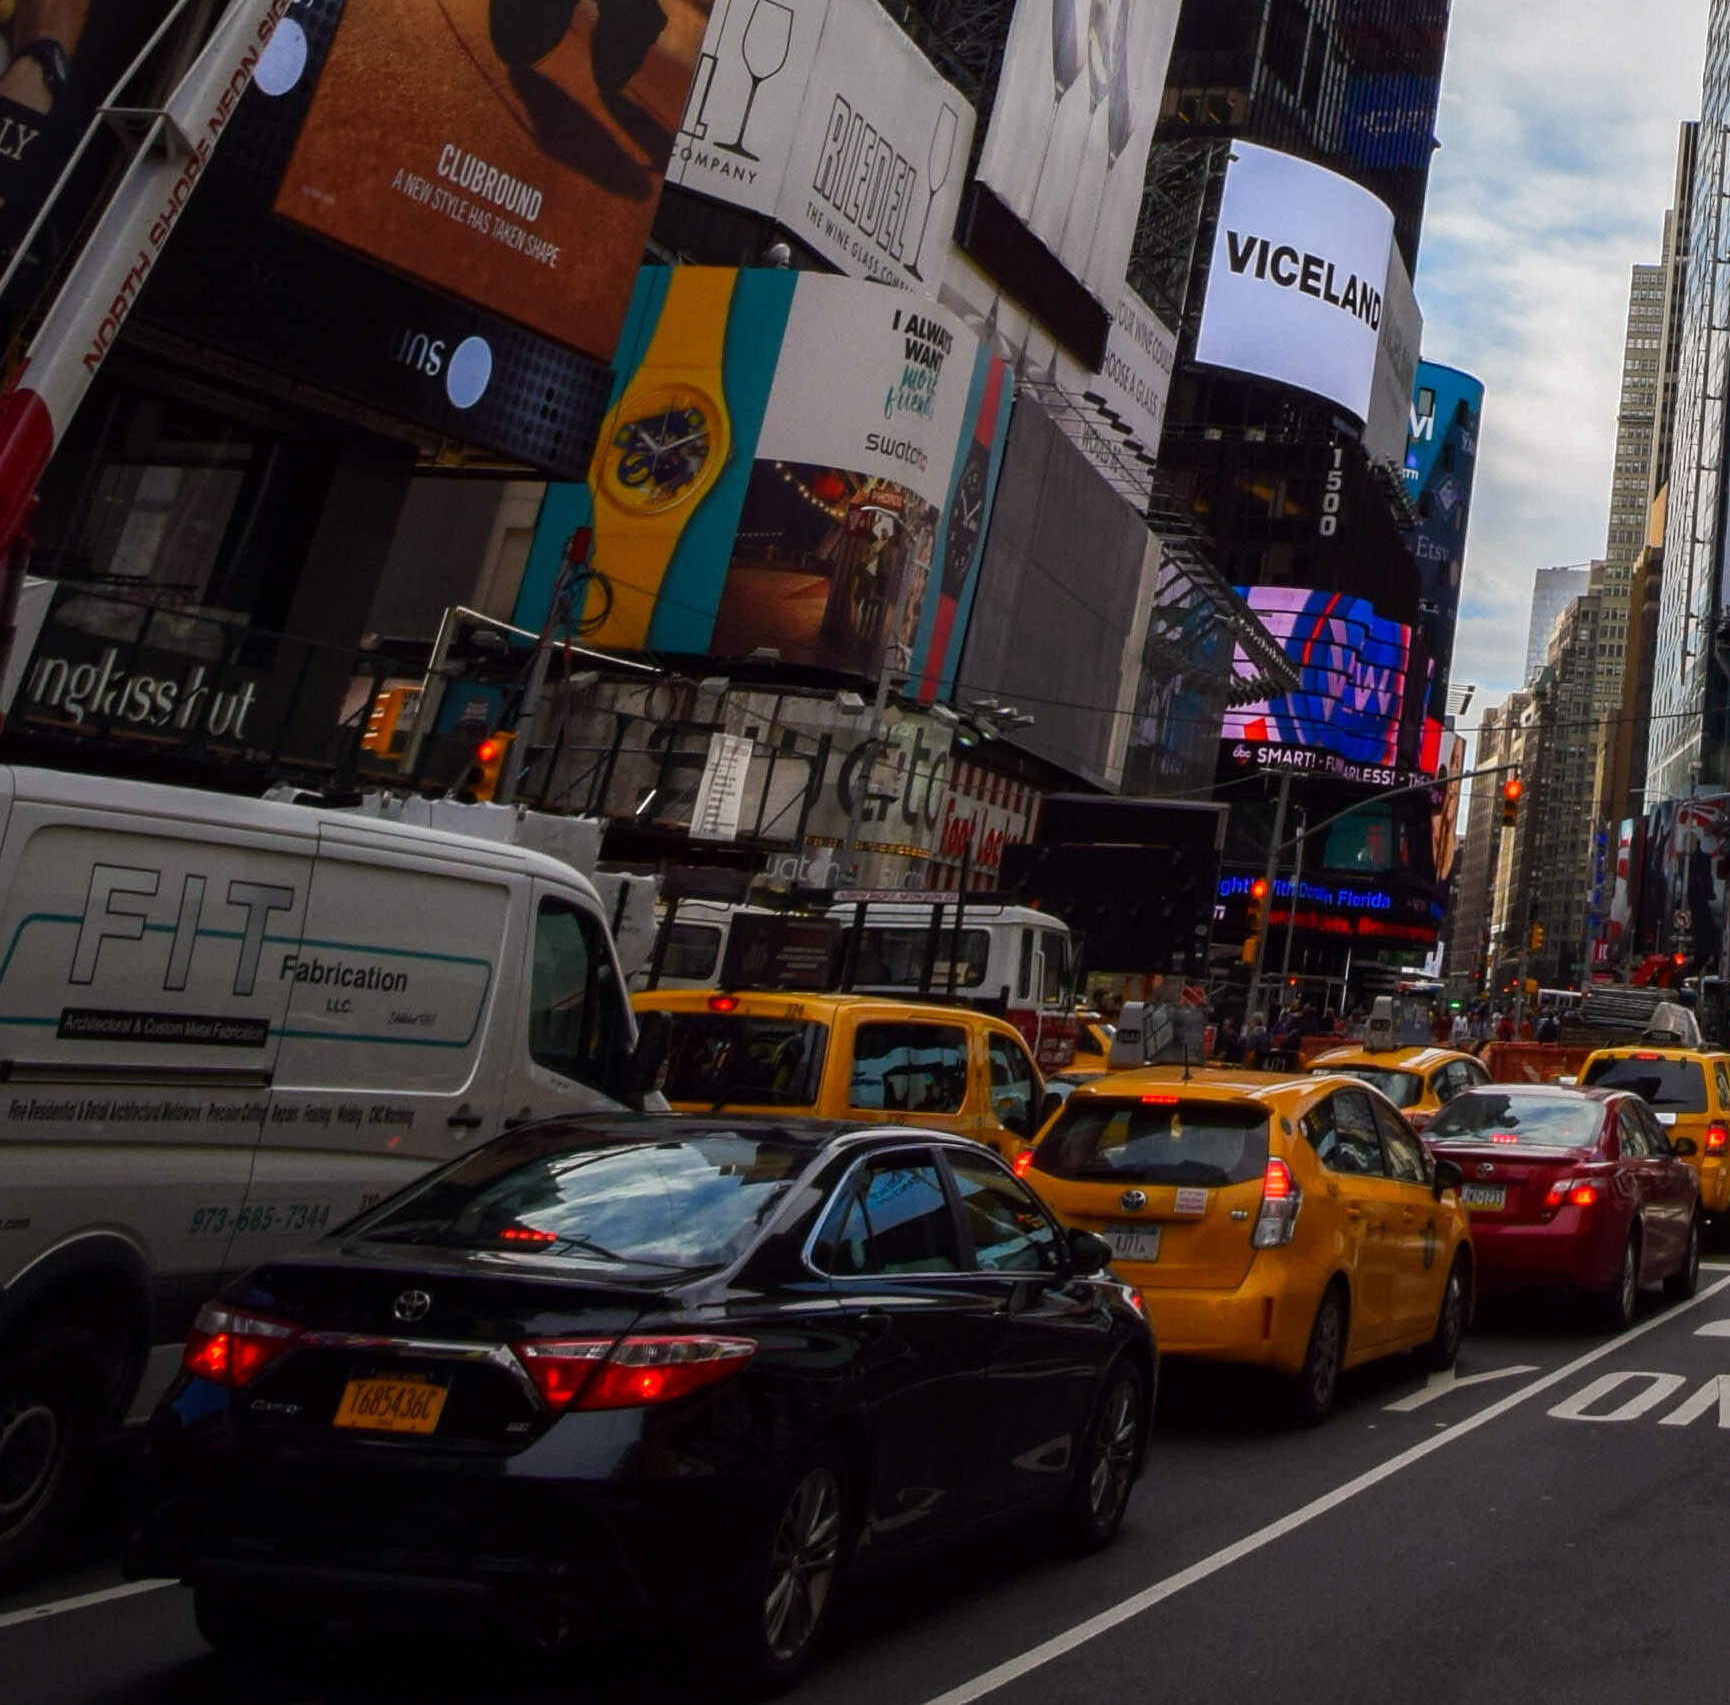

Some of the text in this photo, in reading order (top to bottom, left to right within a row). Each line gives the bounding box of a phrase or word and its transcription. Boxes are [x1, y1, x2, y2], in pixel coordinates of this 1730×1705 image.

[83, 251, 152, 374] NORTH
[148, 137, 210, 258] SHORE
[206, 45, 259, 138] NEON
[437, 143, 544, 223] CLUBROUND
[813, 93, 917, 263] RIEDEL
[391, 167, 561, 270] A NEW STYLE HAS TAKEN SHAPE
[805, 201, 880, 276] THE WINE GLASS
[1225, 230, 1383, 332] VICELAND
[904, 314, 954, 356] ALWAYS
[904, 337, 945, 375] WANT
[1415, 534, 1449, 562] Etsy
[27, 646, 178, 728] nglass
[1256, 747, 1317, 770] SMART!
[69, 862, 295, 997] FIT
[1337, 889, 1393, 911] Florida
[280, 954, 409, 992] Fabrication
